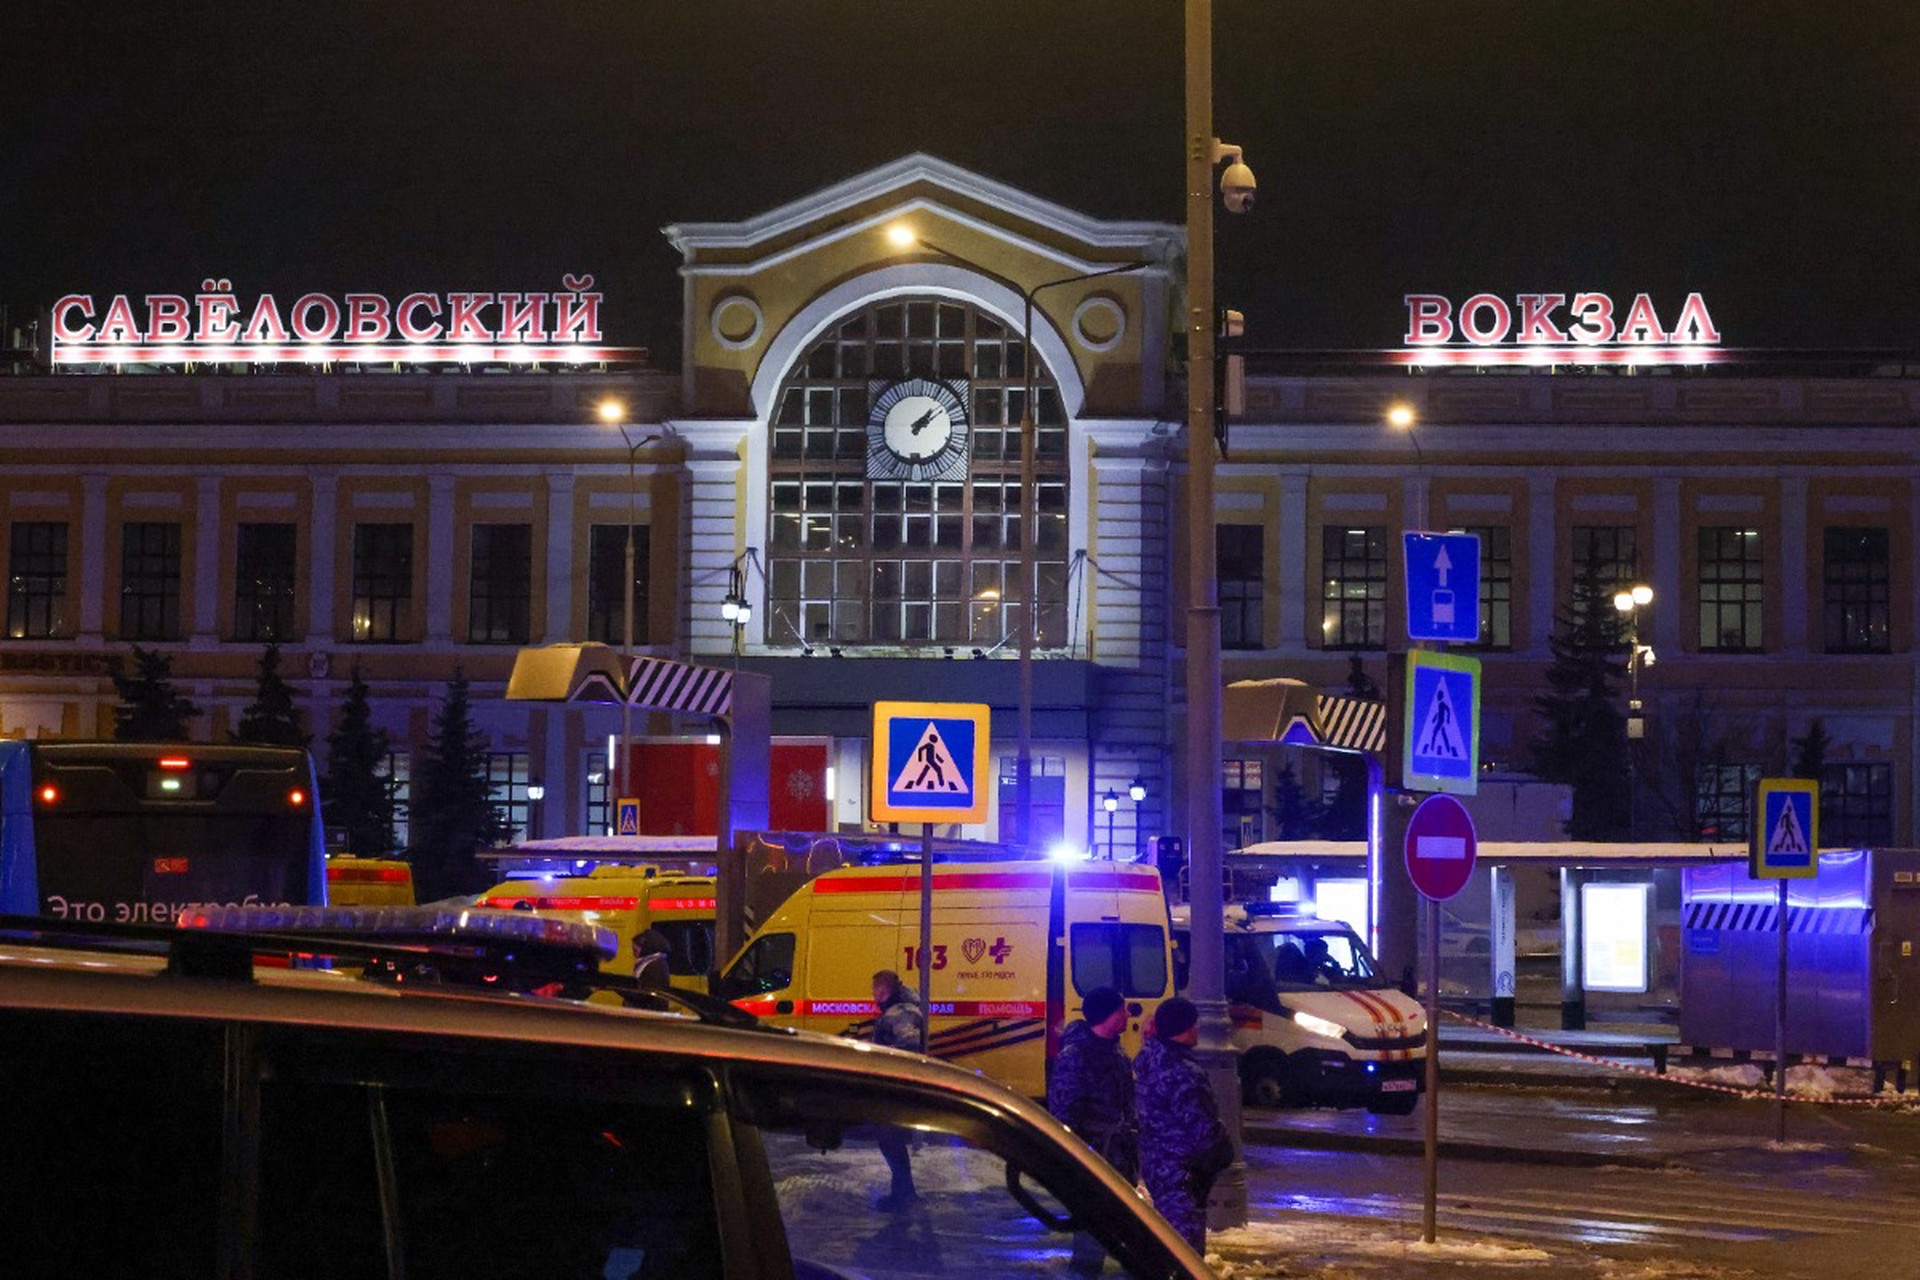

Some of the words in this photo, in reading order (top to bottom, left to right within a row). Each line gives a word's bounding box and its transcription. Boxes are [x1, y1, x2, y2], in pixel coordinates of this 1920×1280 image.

[53, 273, 603, 343] САВЁЛОВСКИЙ
[1404, 292, 1721, 345] ВОКЗАЛ
[47, 895, 105, 922] Это
[978, 1003, 1033, 1015] ПОМОЩЬ
